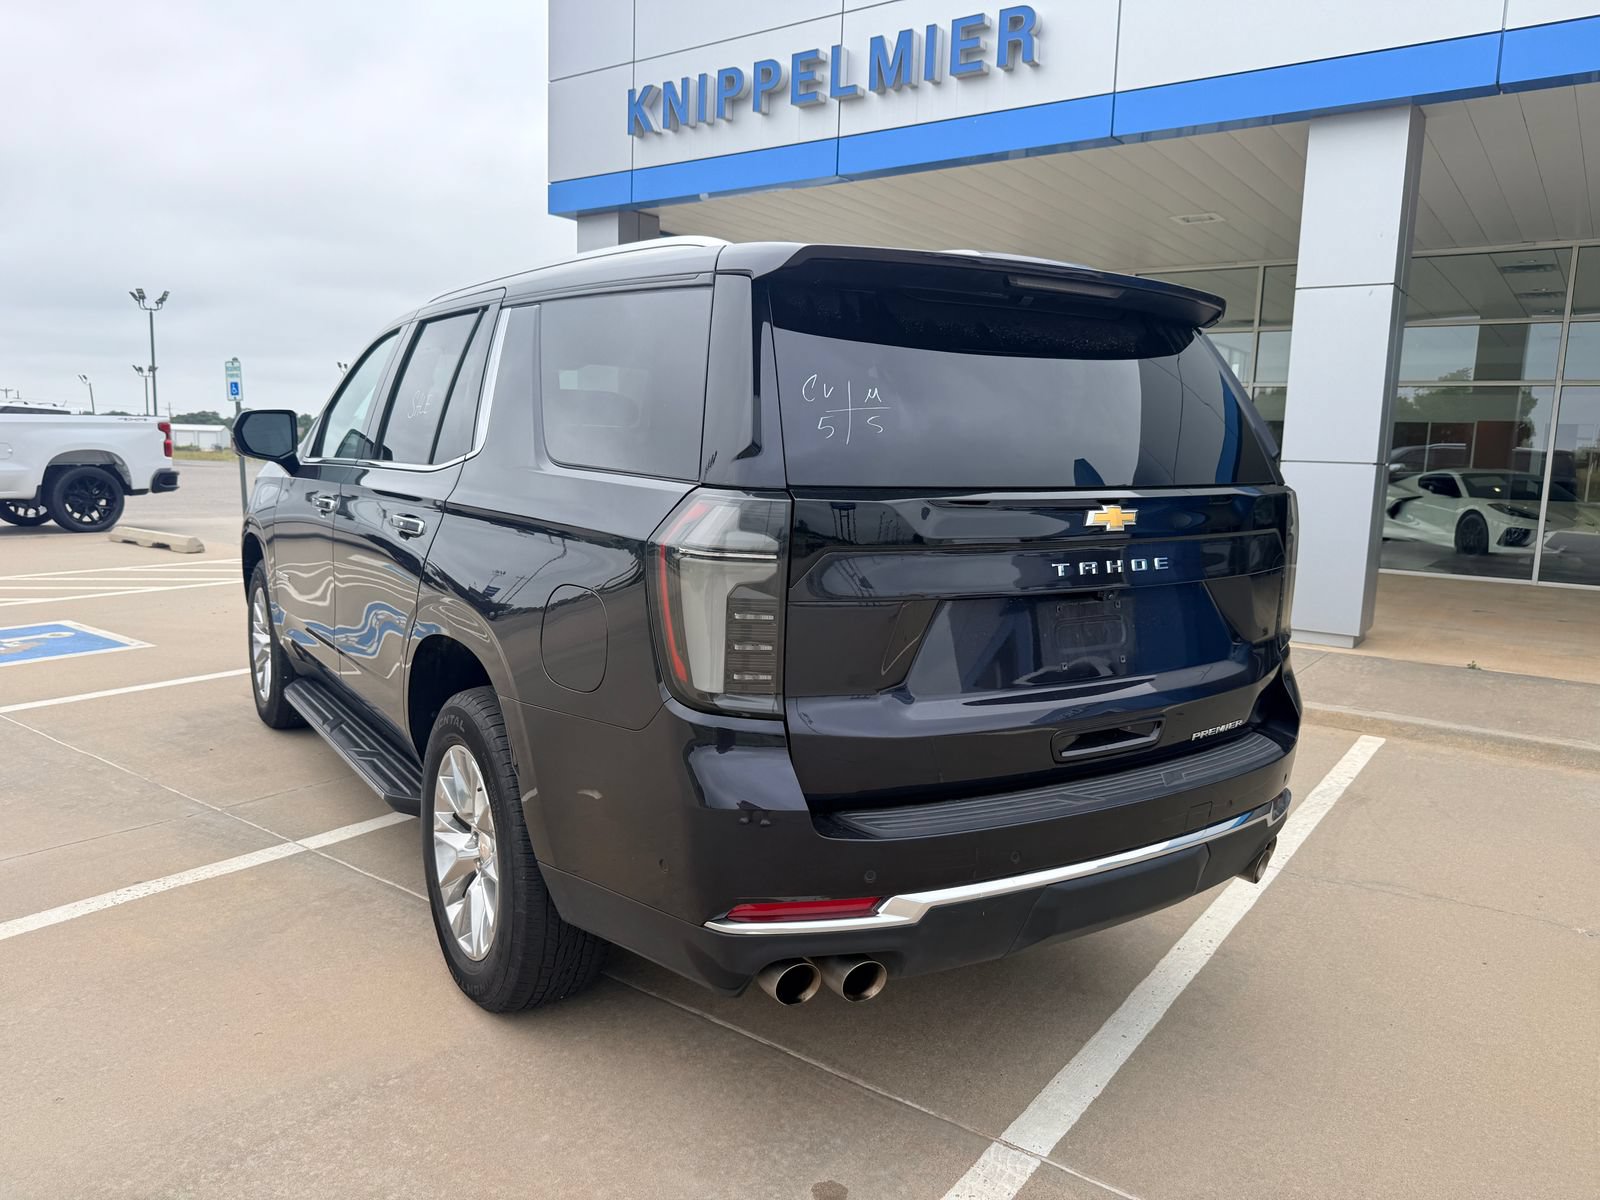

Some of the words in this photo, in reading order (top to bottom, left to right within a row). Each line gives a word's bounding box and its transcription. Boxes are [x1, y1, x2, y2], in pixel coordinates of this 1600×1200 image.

[627, 5, 1041, 137] KNIPPELMIER
[1051, 556, 1170, 577] TAHOE
[1191, 719, 1243, 741] PREMIER
